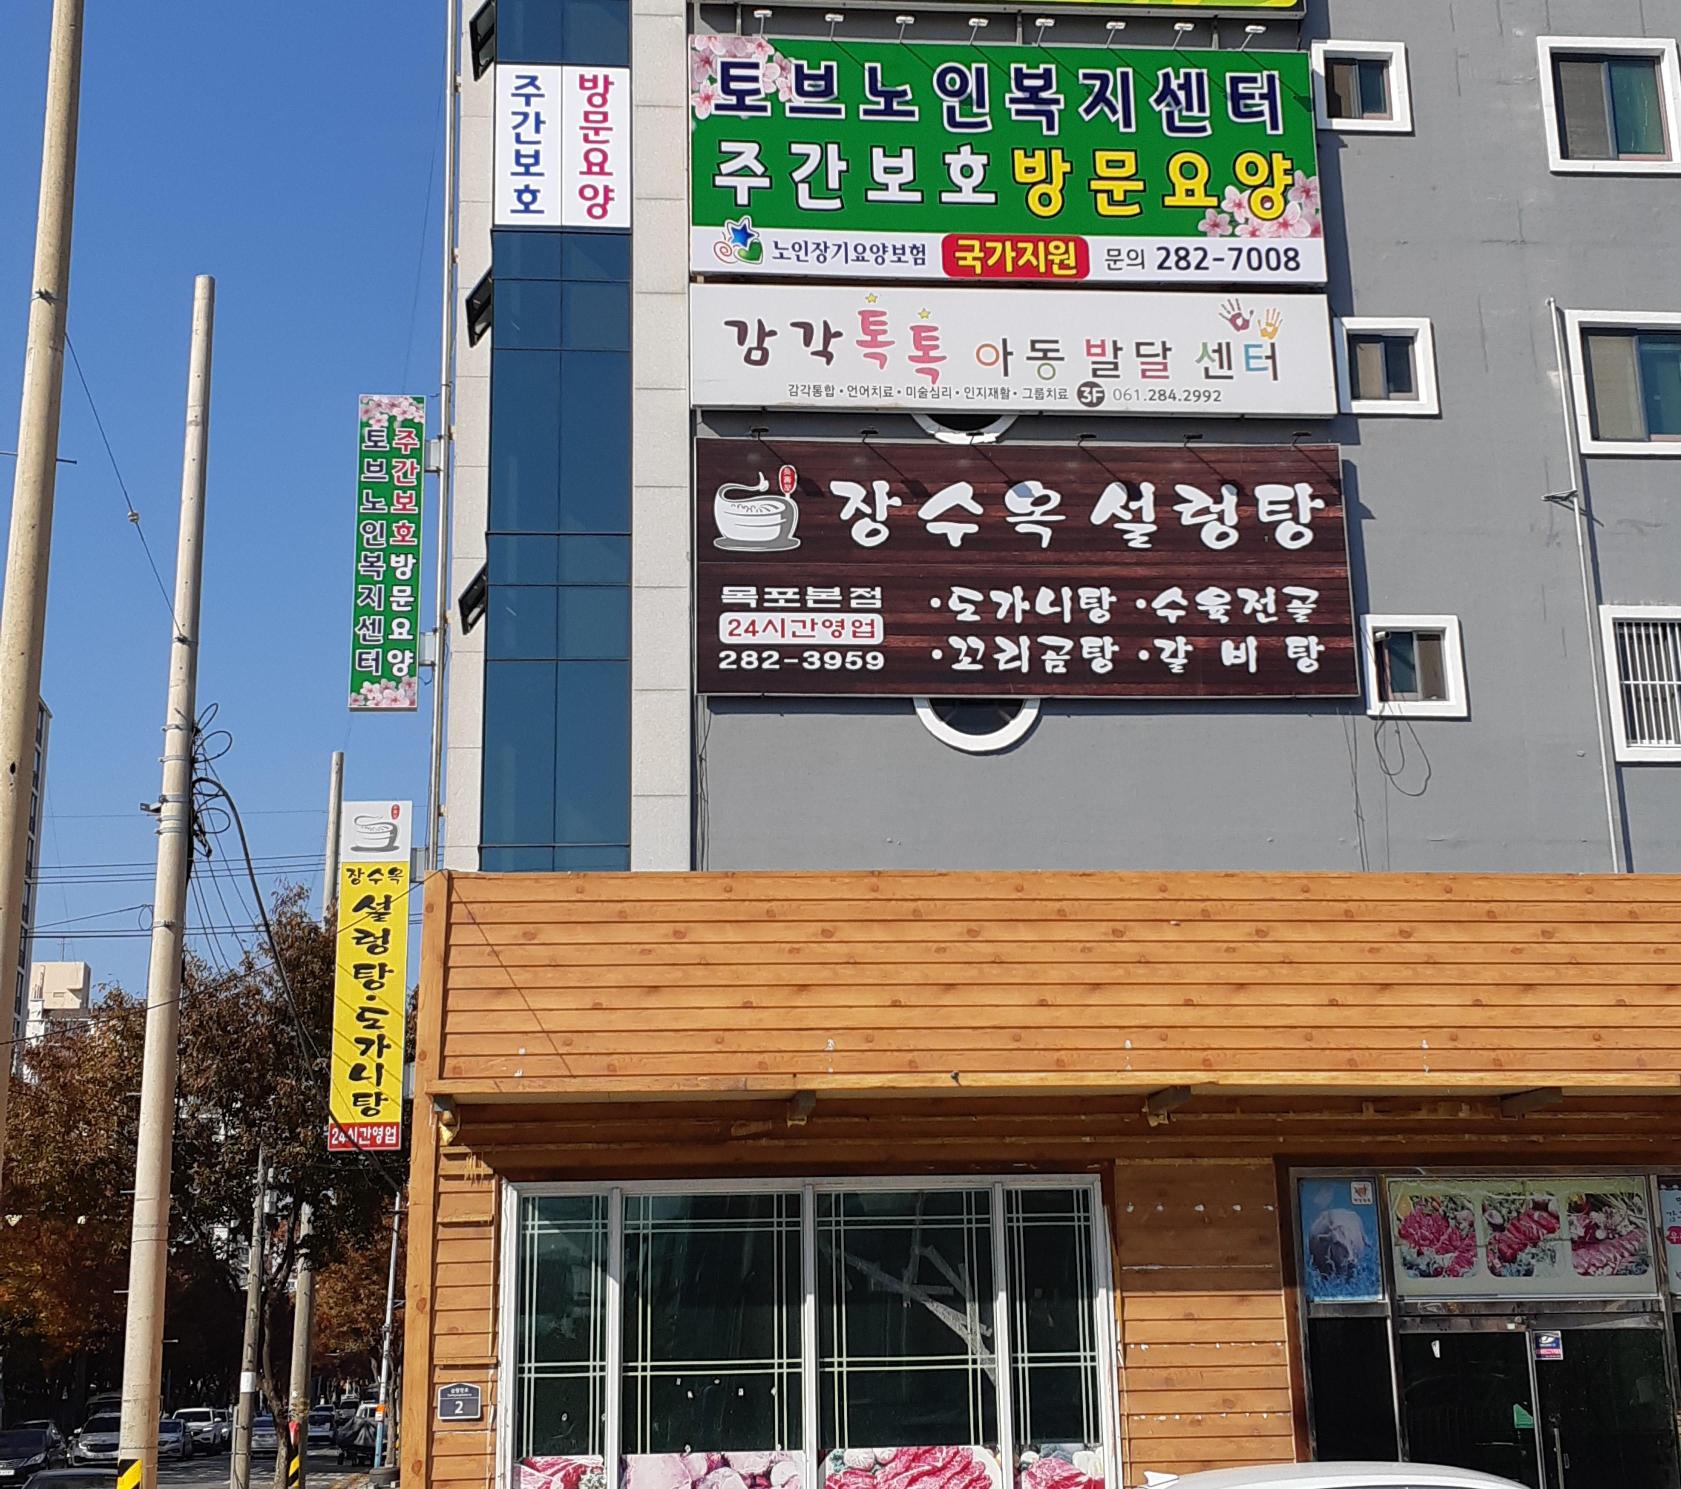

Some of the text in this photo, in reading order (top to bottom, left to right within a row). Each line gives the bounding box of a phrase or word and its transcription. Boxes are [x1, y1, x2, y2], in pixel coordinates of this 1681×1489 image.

[714, 57, 1285, 137] 토브노인복지센터
[510, 74, 546, 214] 주간보호
[578, 74, 615, 220] 방문요양
[771, 240, 928, 268] 노인장기요양보험
[953, 239, 1079, 276] 국가지원
[1104, 245, 1301, 273] 문의 282-7008
[724, 308, 947, 384] 감각톡톡
[1079, 387, 1106, 404] 3F
[1112, 387, 1222, 403] 061.284.2992
[829, 479, 1327, 550] 장수옥 설렁탕
[355, 427, 389, 677] 토브노인복지센터
[720, 585, 883, 610] 목포본점
[726, 617, 877, 641] 24시간영업
[718, 649, 886, 672] 282-3959
[345, 867, 404, 886] 장수옥
[454, 1400, 464, 1415] 2
